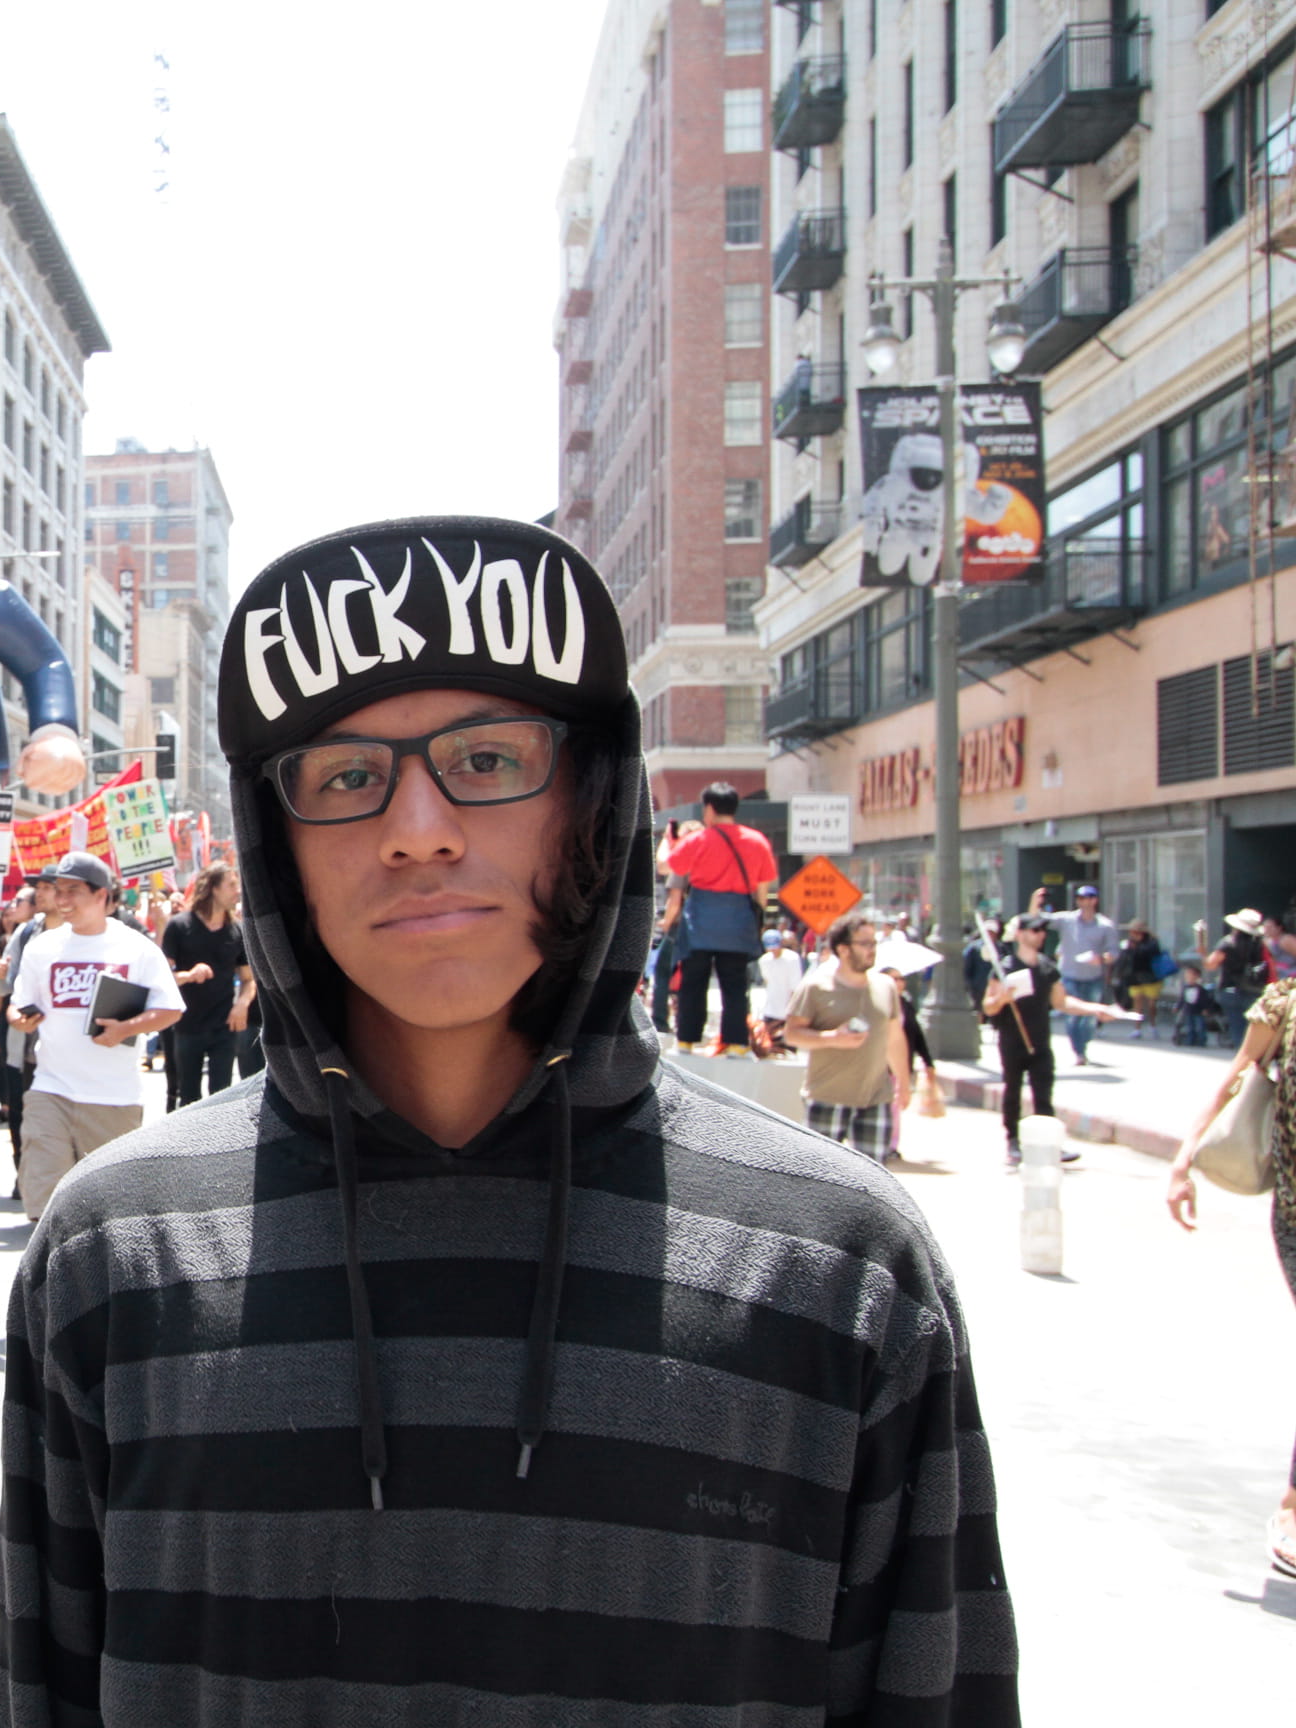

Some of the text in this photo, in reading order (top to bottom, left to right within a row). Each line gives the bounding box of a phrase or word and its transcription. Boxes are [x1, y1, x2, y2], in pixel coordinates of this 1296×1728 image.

[872, 405, 1032, 428] SPACE
[244, 545, 427, 721] FUCK
[421, 536, 585, 685] YOU
[108, 785, 155, 807] POWER
[132, 802, 155, 818] THE
[116, 819, 163, 841] PEOPLE
[799, 818, 840, 829] MUST
[803, 874, 836, 885] ROAD
[803, 889, 835, 899] WORK
[801, 903, 840, 914] AHEAD
